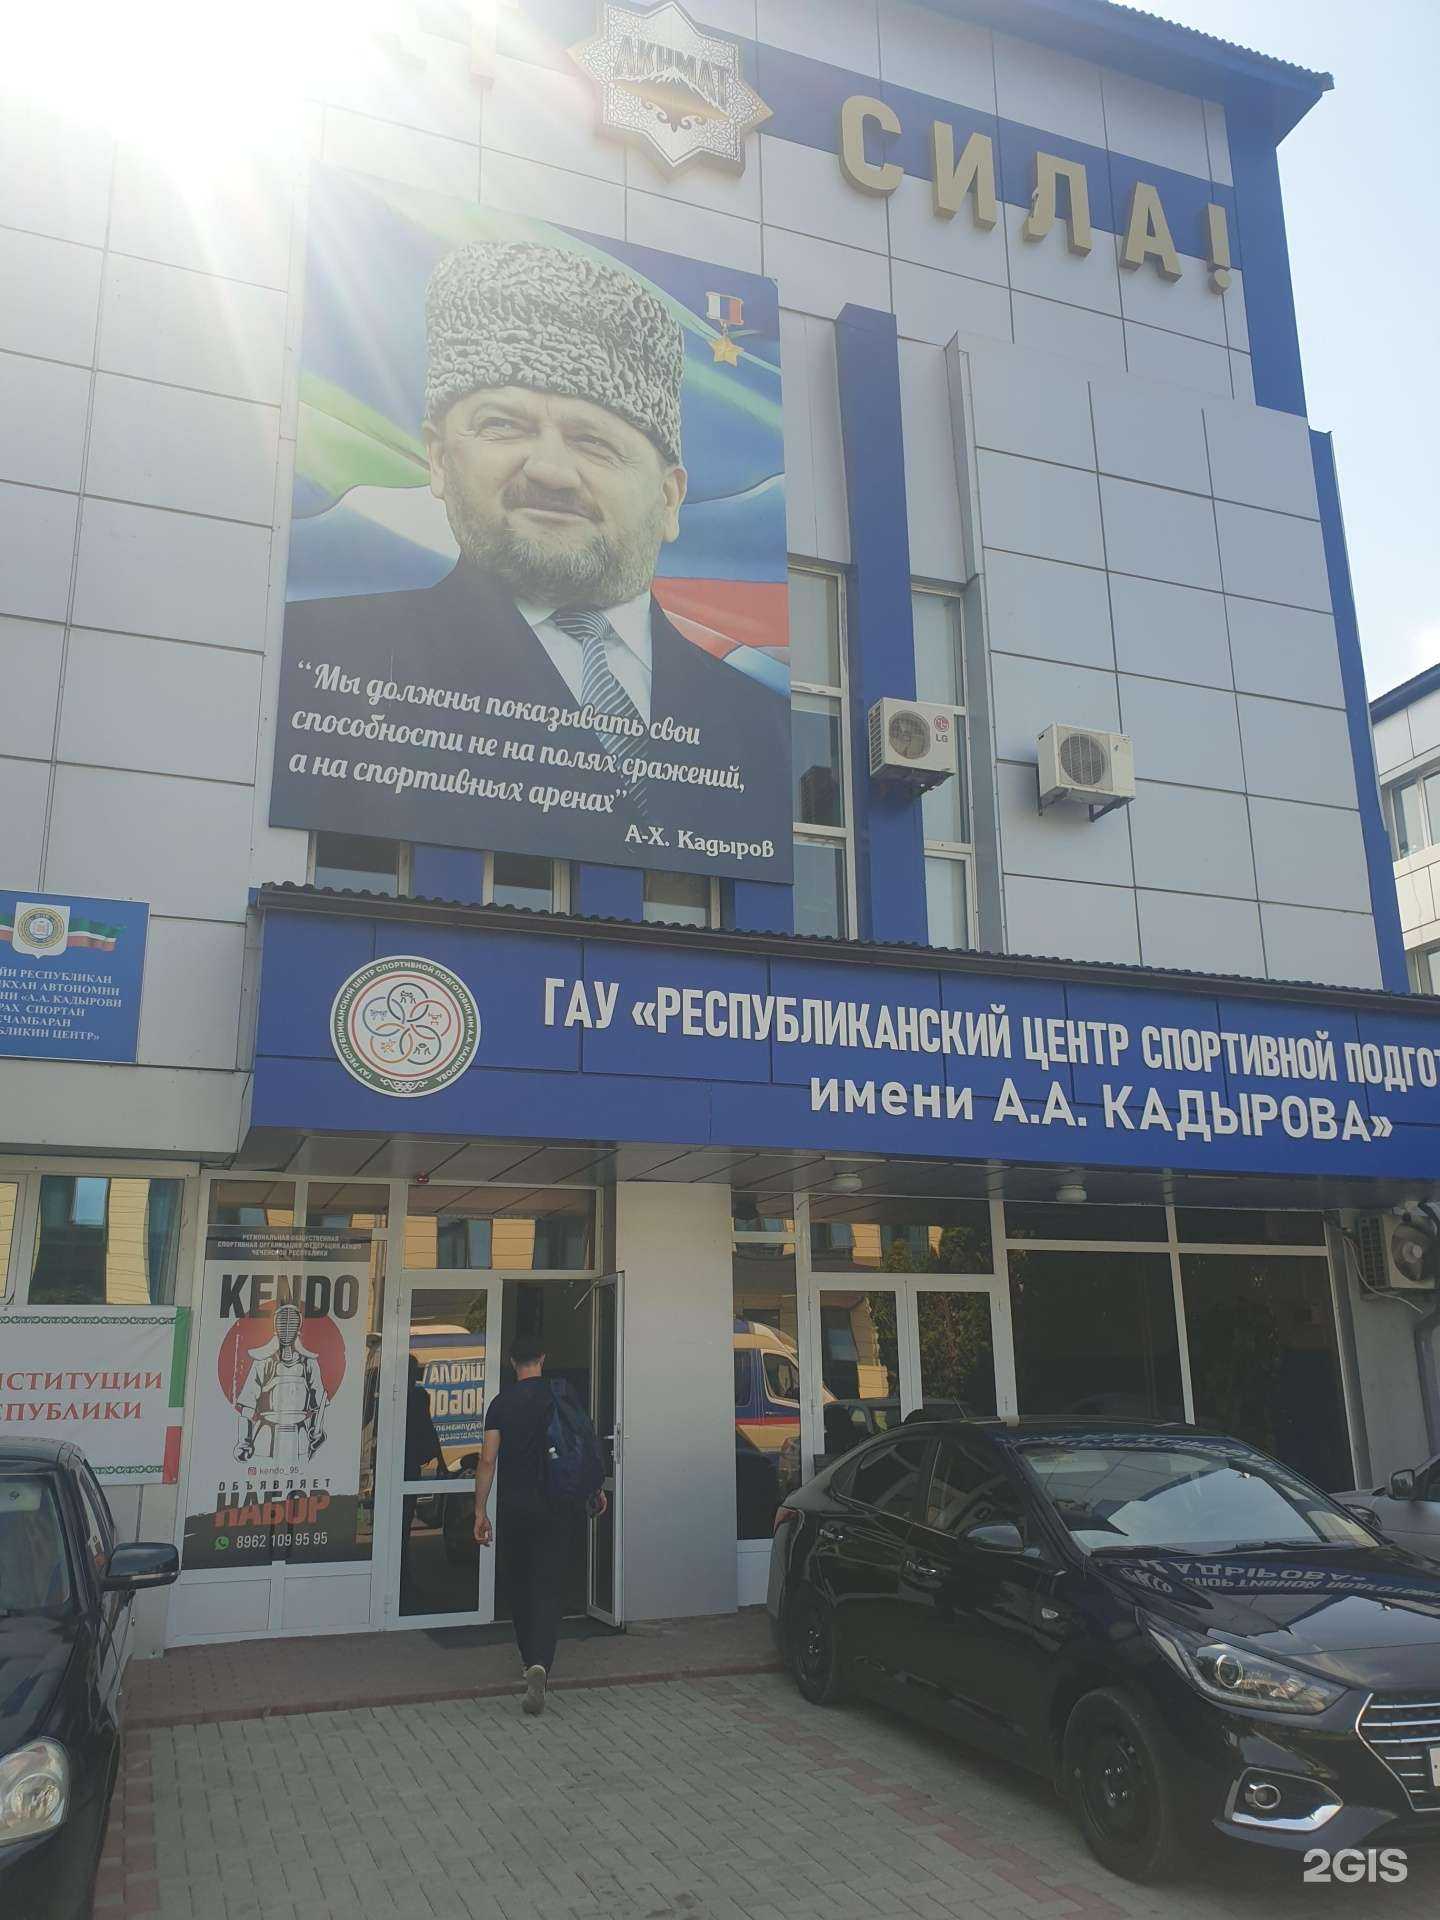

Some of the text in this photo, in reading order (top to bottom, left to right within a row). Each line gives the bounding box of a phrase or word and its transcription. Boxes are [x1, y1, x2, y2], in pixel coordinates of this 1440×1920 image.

[838, 95, 1232, 294] СИЛА!
[366, 672, 482, 714] должны
[486, 697, 644, 740] показывать
[650, 719, 702, 746] свои
[291, 708, 745, 793] способности не на полях сражений,
[935, 734, 948, 743] LG
[288, 752, 307, 773] а
[311, 754, 349, 778] на
[352, 760, 524, 802] спортивных
[624, 823, 775, 861] А-Х. Кадыров
[20, 969, 113, 985] РЕСПУБЛИКАН
[544, 977, 619, 1029] ГАУ
[631, 986, 1012, 1058] «РЕСПУБЛИКАНСКИЙ
[1022, 1015, 1129, 1070] ЦЕНТР
[1142, 1026, 1338, 1082] СПОРТИВНОЙ
[994, 1077, 1087, 1127] А.А.
[1102, 1084, 1394, 1143] КАДЫРОВА»
[219, 1274, 360, 1320] KENDO
[0, 1402, 142, 1420] ПУБЛИКИ
[219, 1478, 331, 1491] ОБЪЯВЛЯЕТ
[236, 1532, 328, 1549] 8962 109 95 95
